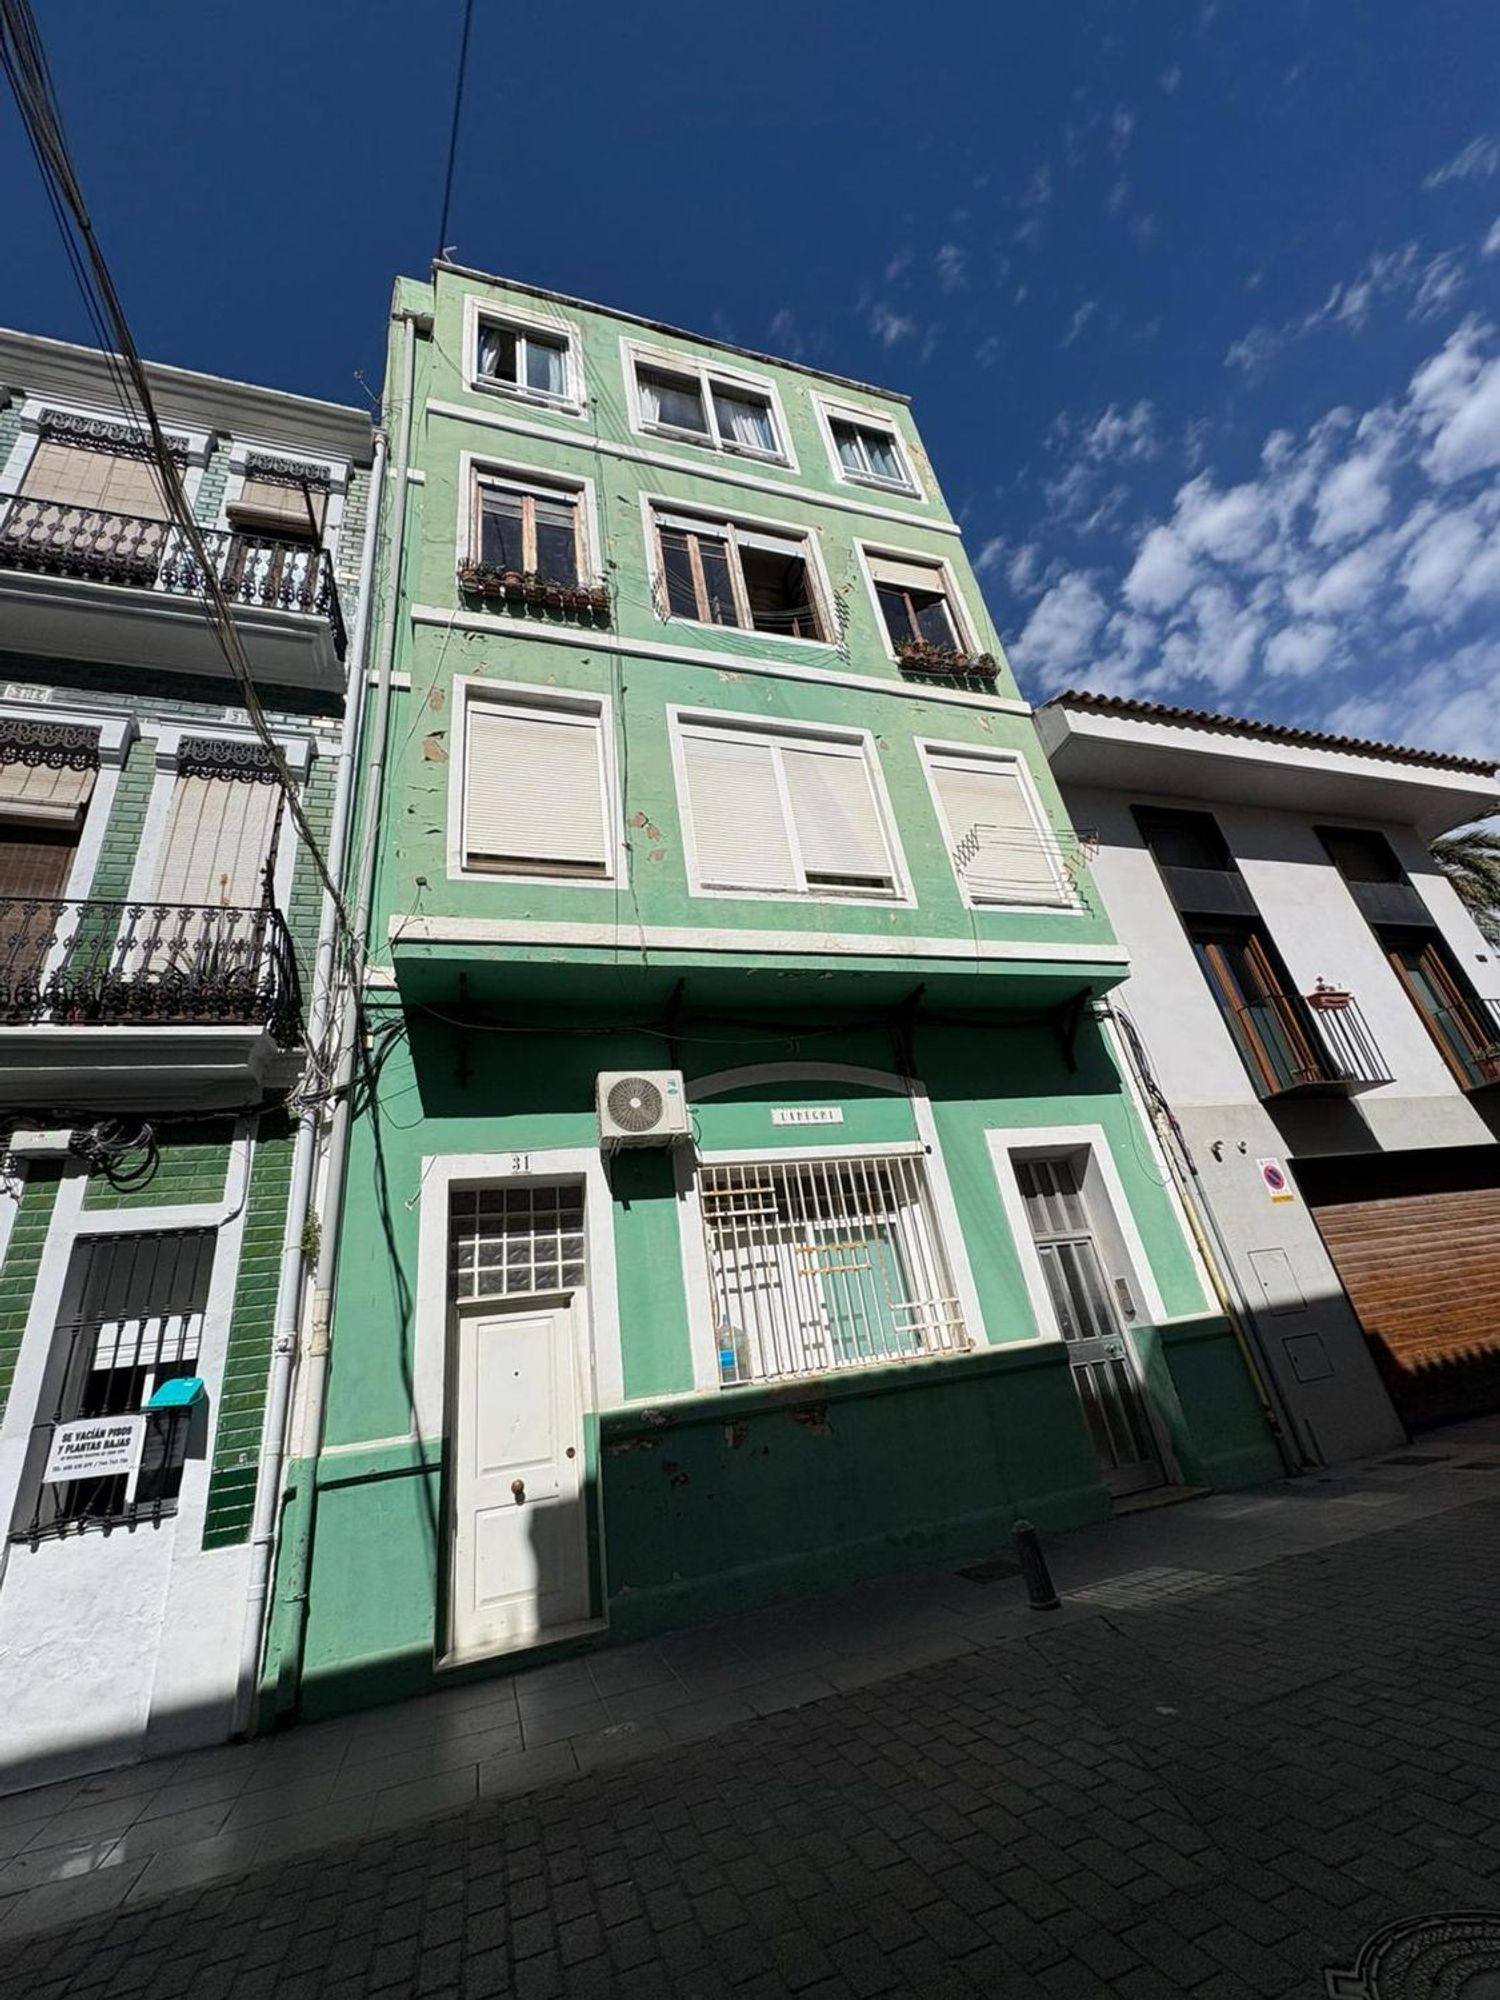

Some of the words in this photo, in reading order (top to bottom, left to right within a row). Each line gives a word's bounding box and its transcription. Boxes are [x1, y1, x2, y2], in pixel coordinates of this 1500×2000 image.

[512, 1154, 529, 1170] 31
[62, 1432, 73, 1443] SE
[107, 1426, 133, 1437] PISOS
[58, 1444, 64, 1455] Y
[65, 1441, 102, 1454] PLANTAS
[103, 1438, 131, 1449] BAJAS
